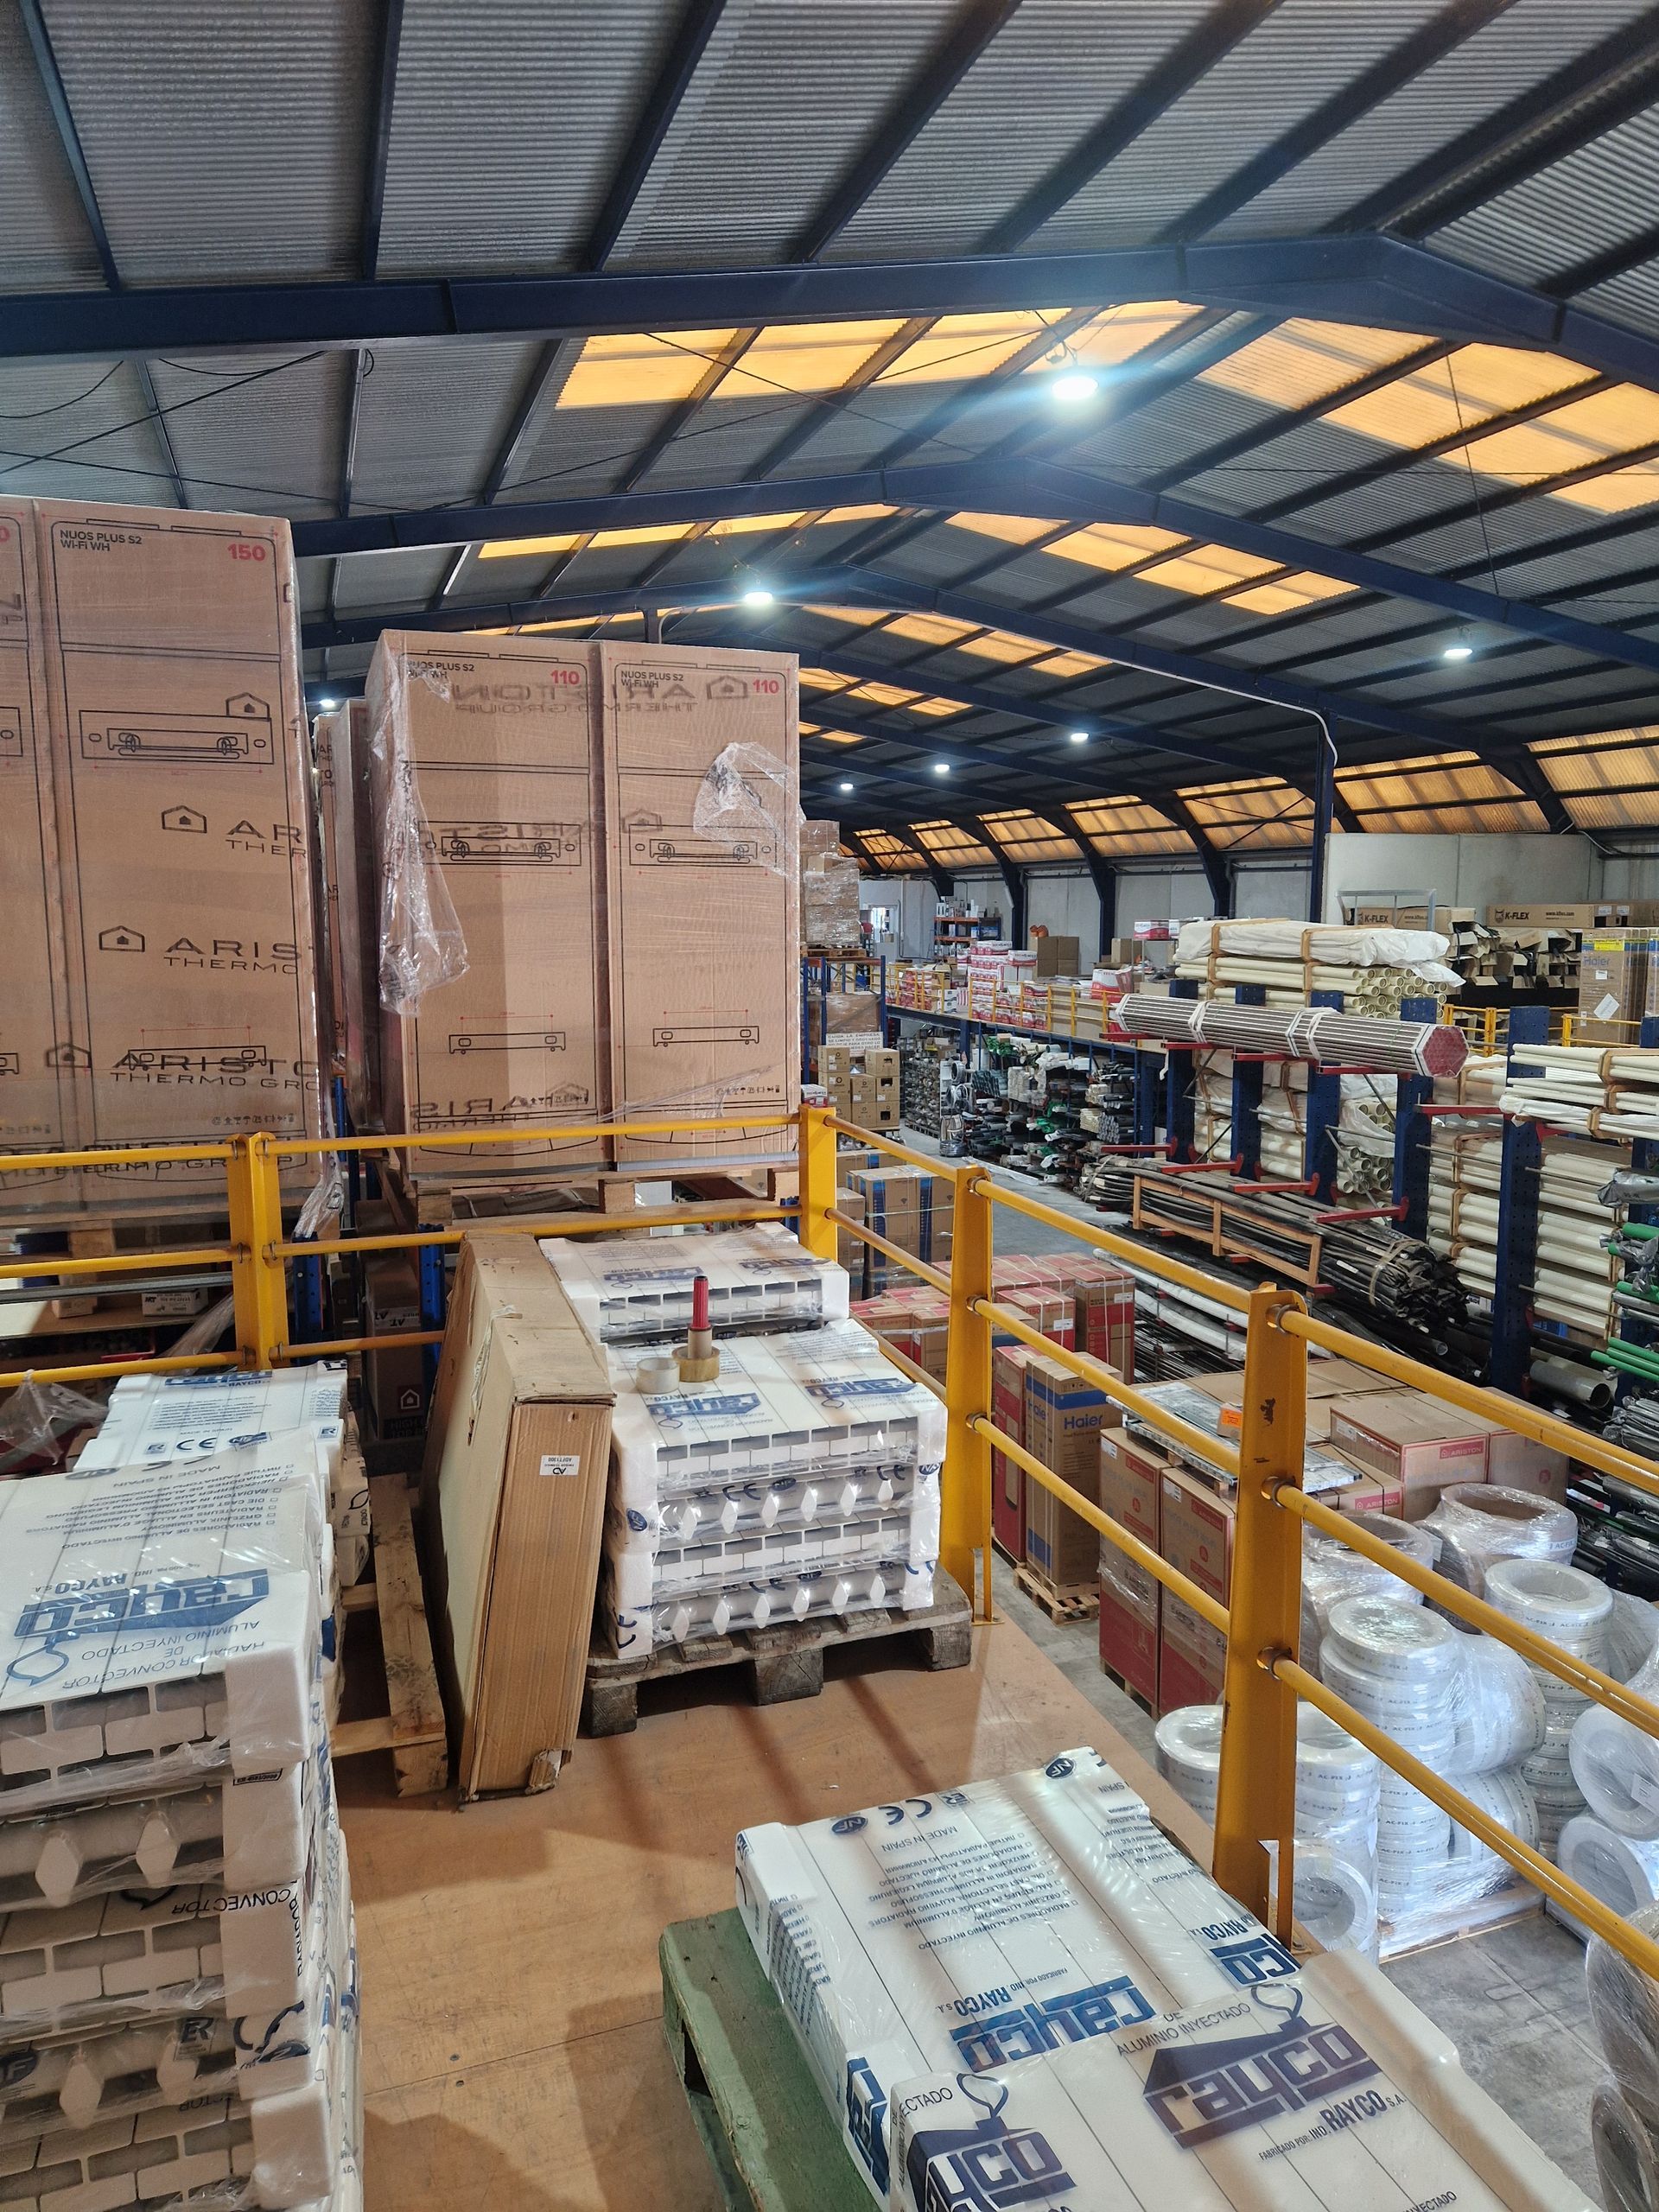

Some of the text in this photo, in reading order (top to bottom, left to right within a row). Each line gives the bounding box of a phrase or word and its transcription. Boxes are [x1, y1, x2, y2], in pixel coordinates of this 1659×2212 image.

[60, 530, 143, 545] NUOS PLUS S2
[89, 542, 111, 552] WH
[227, 543, 267, 562] 150
[435, 661, 461, 672] PLUS
[462, 663, 475, 672] S2
[550, 670, 580, 685] 110
[620, 671, 684, 682] NUOS PLUS S2
[620, 678, 659, 689] Wi-Fi WH
[752, 679, 779, 695] 110
[226, 819, 303, 844] AR
[1364, 914, 1389, 923] K-FLEX
[1504, 912, 1529, 920] K-FLEX
[1583, 956, 1611, 966] Haier
[109, 1071, 246, 1087] THERMO
[1064, 1414, 1103, 1431] Haier
[175, 1437, 217, 1451] CE
[1450, 1446, 1483, 1457] ARISTON
[176, 1465, 221, 1478] MADE
[112, 1478, 155, 1488] SPAIN
[212, 1488, 269, 1501] RADIATORI
[1366, 1497, 1398, 1510] ARISTON
[196, 1506, 264, 1517] RADIATEURS
[192, 1521, 261, 1532] RADIADORES
[54, 1572, 128, 1597] RAYCO
[14, 1573, 270, 1639] rayco
[80, 1619, 260, 1662] ALUMINIO INYECTADO
[163, 1644, 185, 1658] DE
[61, 1657, 177, 1690] CONVECTOR
[1097, 1782, 1125, 1794] SPAIN
[877, 1797, 933, 1827] CE
[880, 1826, 958, 1853] MADE IN SPAIN
[170, 1888, 291, 1915] CONVECTOR
[1199, 1915, 1248, 1942] RAYCO
[918, 1931, 966, 1950] INYECTADO
[952, 1985, 1014, 2018] RAYCO
[1164, 2011, 1185, 2023] DE
[952, 1986, 1155, 2074] rayco
[1117, 2001, 1253, 2058] ALUMINIO INYECTADO
[1143, 2022, 1370, 2136] rayco
[1258, 2089, 1408, 2162] FABRICADO POR: IND. RAYCO S.A.
